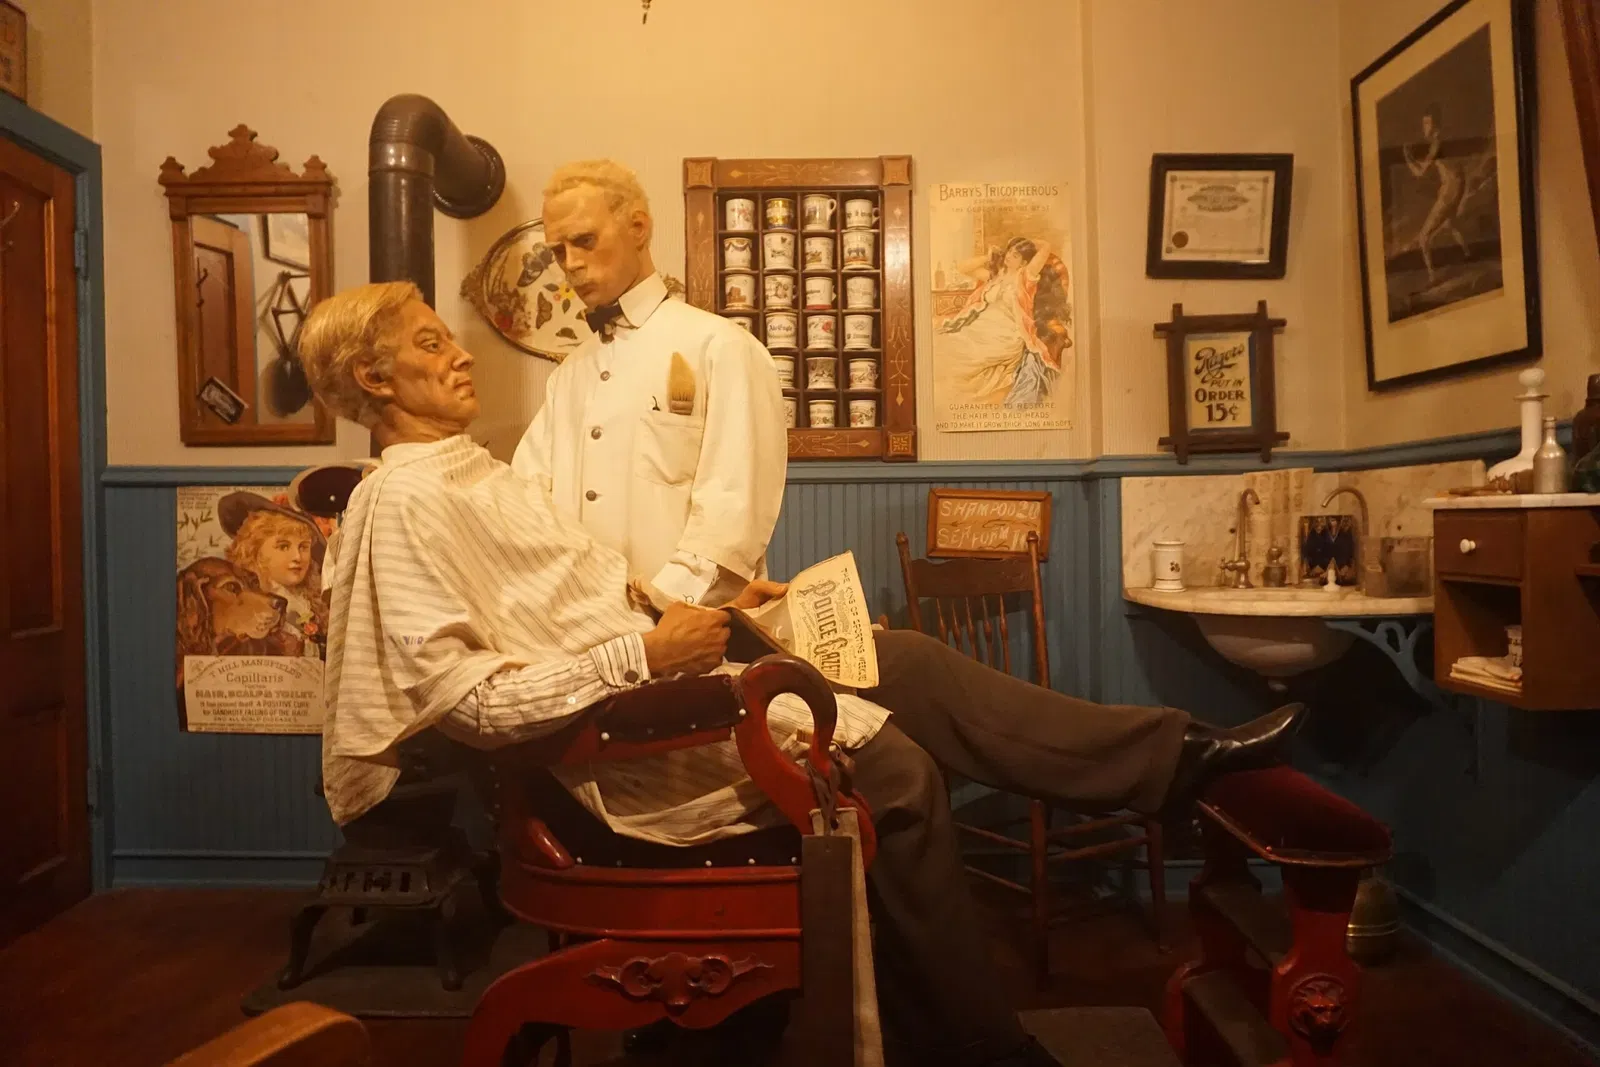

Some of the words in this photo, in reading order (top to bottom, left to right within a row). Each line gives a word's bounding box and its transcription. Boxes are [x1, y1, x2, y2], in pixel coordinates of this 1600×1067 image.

[940, 183, 982, 201] BARRY'S
[983, 182, 1059, 198] TRICOPHEROUS
[1210, 379, 1231, 388] PUT
[1232, 377, 1246, 388] IN
[1194, 388, 1246, 403] ORDER
[949, 403, 999, 411] GUARANTEED
[1003, 402, 1013, 410] TO
[1017, 402, 1055, 410] RESTORE
[953, 412, 966, 420] THE
[992, 411, 1001, 419] TO
[1003, 411, 1021, 419] BALD
[1026, 410, 1050, 418] HEADS
[941, 500, 1015, 520] SHAMPOO
[841, 567, 851, 584] THE
[845, 586, 856, 604] KING
[796, 579, 838, 639] POLICE
[850, 606, 859, 616] OF
[852, 619, 865, 654] SPORTING
[227, 672, 284, 686] Capillaris
[228, 690, 263, 698] SCALP
[263, 700, 292, 708] POSITIVE
[294, 700, 310, 709] CURE
